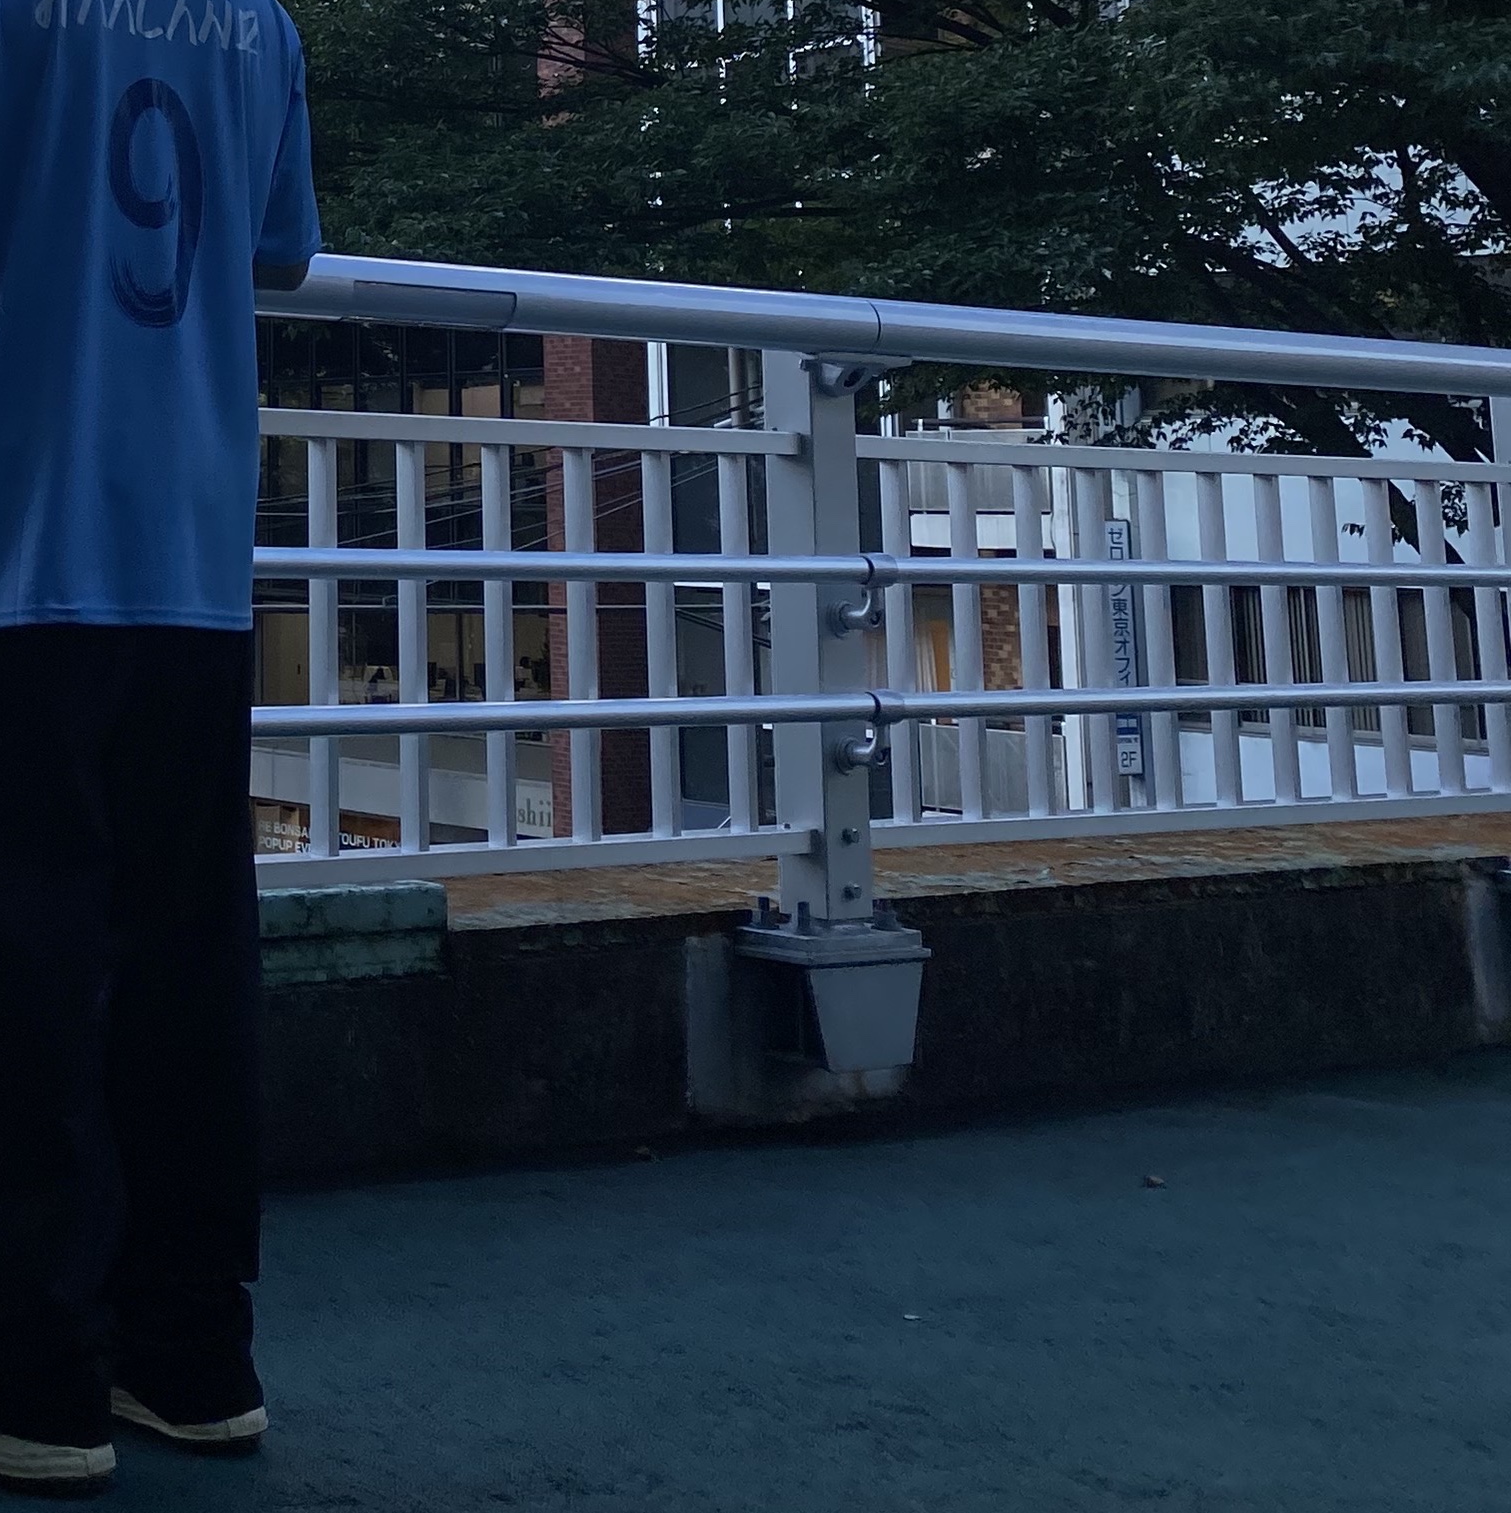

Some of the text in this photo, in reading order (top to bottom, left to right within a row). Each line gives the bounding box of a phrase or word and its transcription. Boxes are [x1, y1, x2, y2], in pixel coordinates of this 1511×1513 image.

[108, 77, 203, 329] 9
[1120, 751, 1137, 768] 2F
[273, 822, 310, 839] BONSA
[339, 832, 370, 848] OUFU
